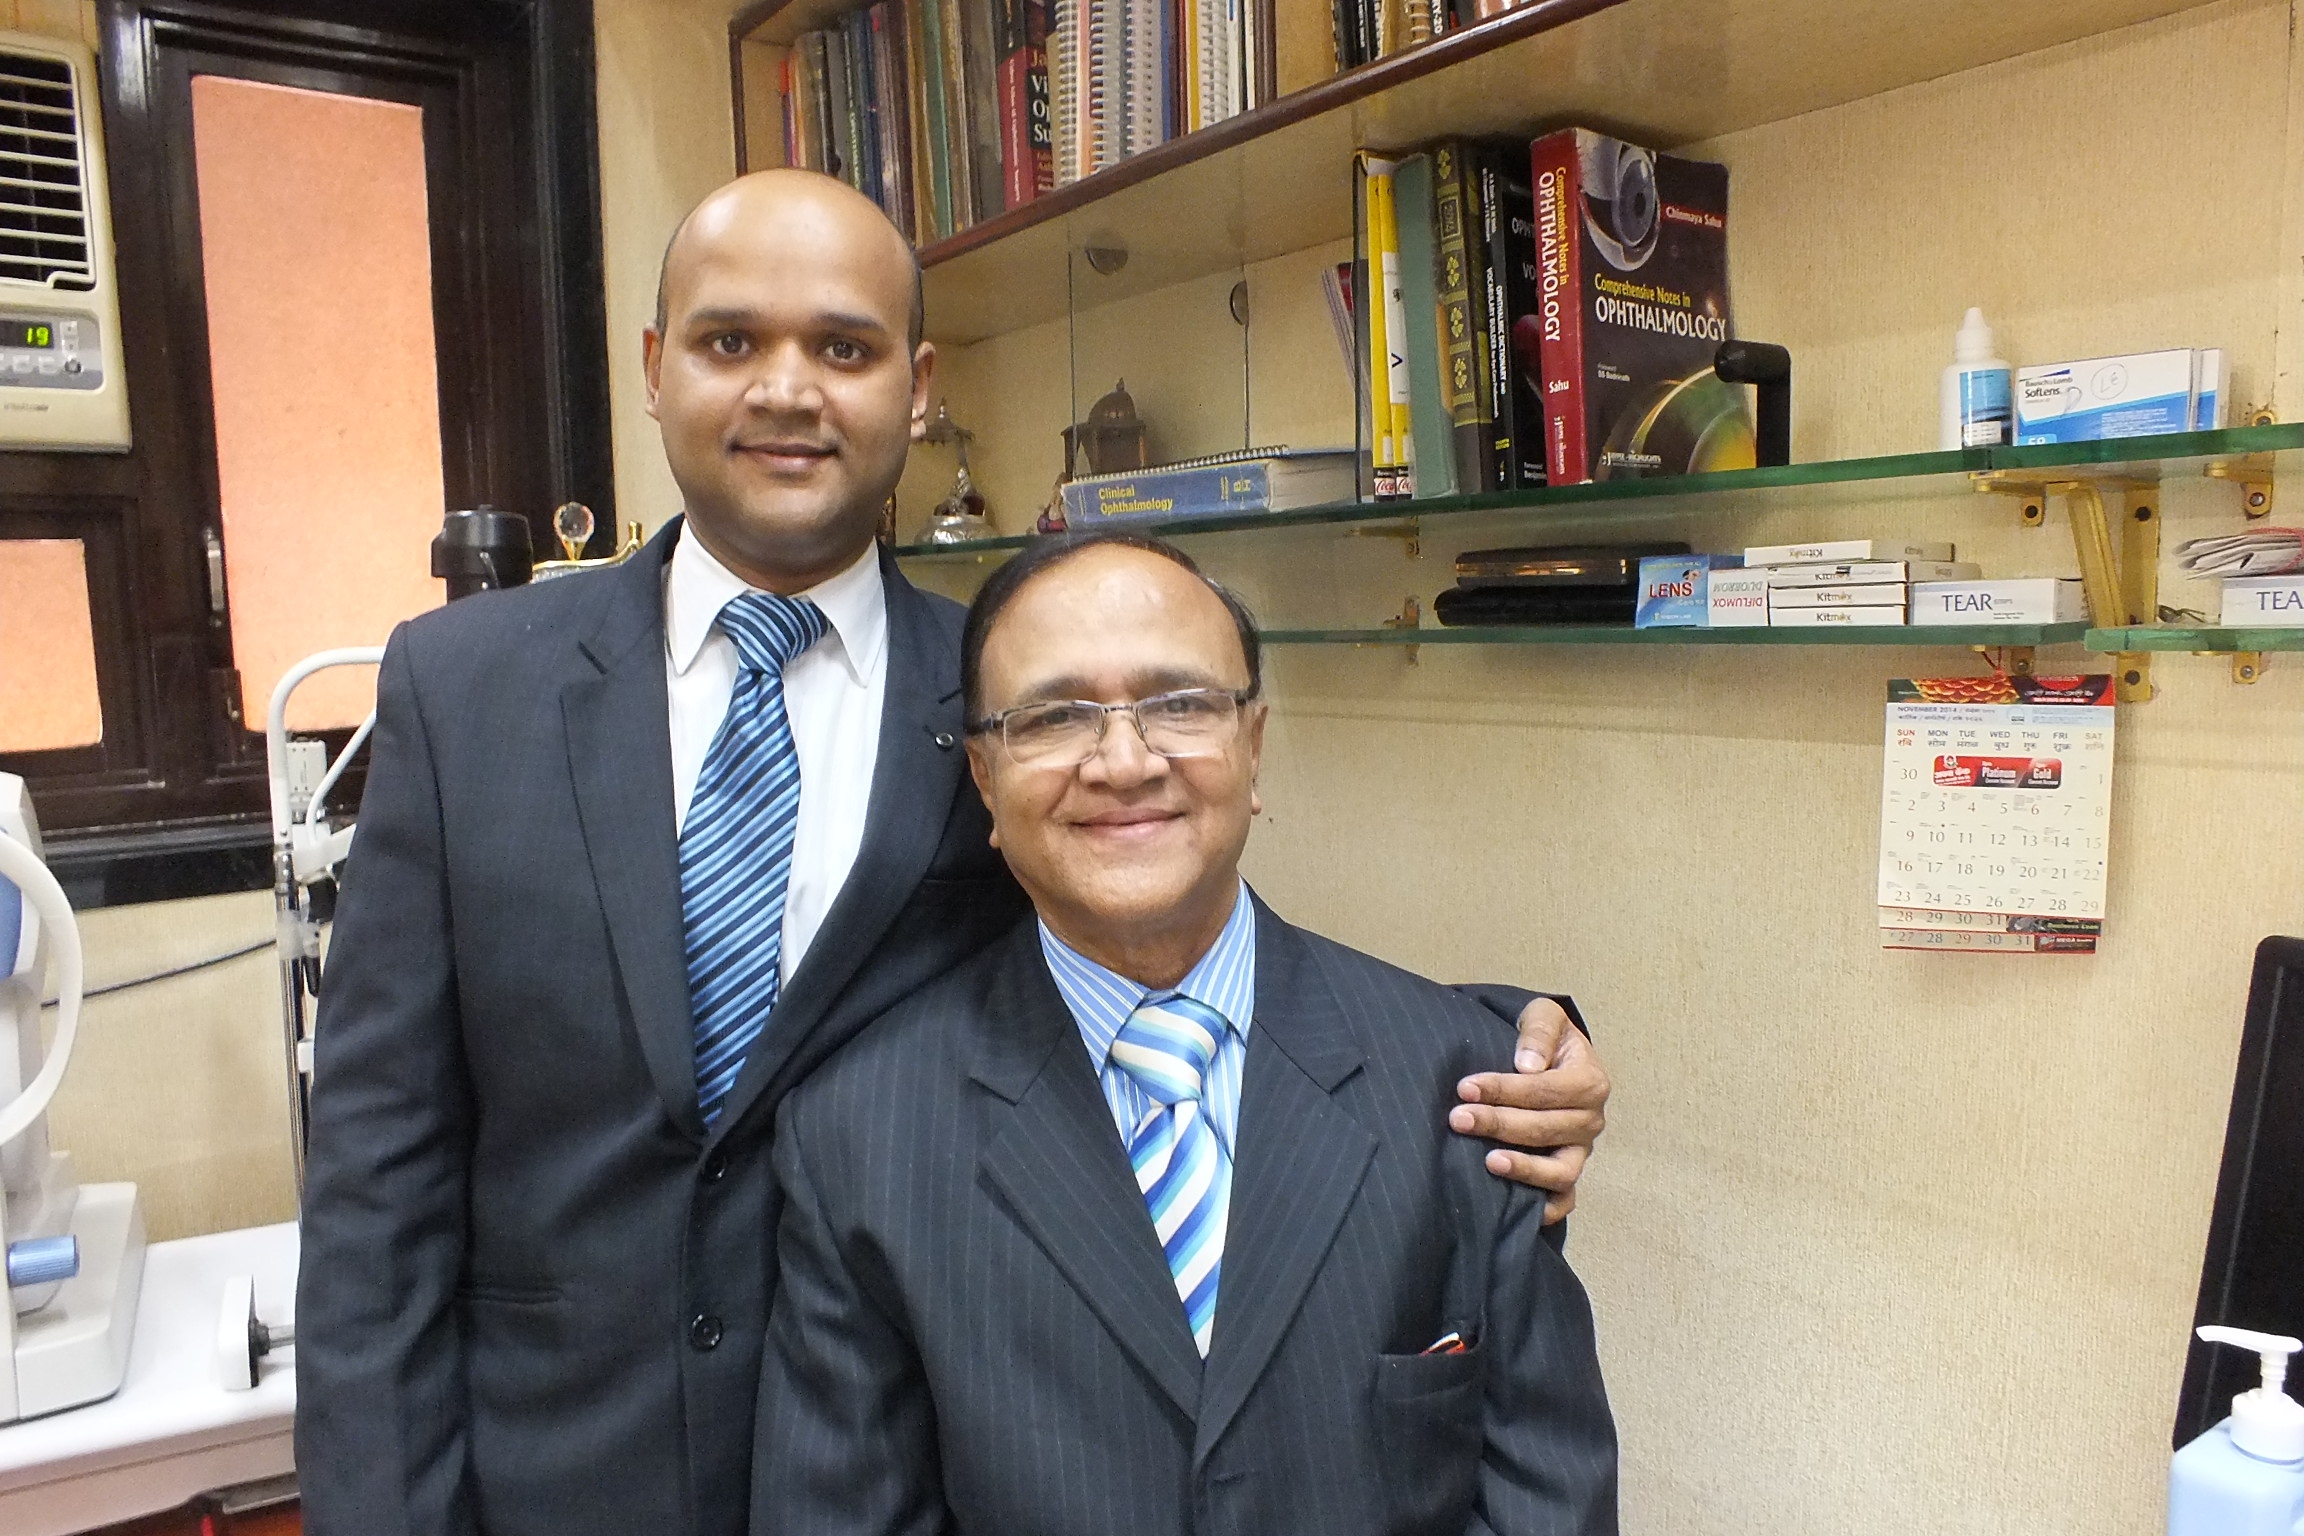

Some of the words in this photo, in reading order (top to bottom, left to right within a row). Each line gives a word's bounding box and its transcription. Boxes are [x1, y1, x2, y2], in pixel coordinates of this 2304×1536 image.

[1556, 167, 1567, 241] Comprehensive
[1705, 214, 1721, 227] Sahu
[1540, 172, 1560, 341] OPHTHALMOLOGY
[1559, 243, 1569, 273] Notes
[1559, 275, 1569, 286] in
[1595, 273, 1654, 301] Comprehensive
[1656, 286, 1680, 306] Notes
[1683, 292, 1691, 307] in
[1595, 296, 1726, 341] OPHTHALMOLOGY
[27, 327, 49, 346] 19
[1549, 380, 1569, 393] Sahu
[2025, 387, 2060, 398] SofLens
[1099, 484, 1135, 499] Clinical
[1101, 497, 1173, 516] Ophthalmology
[1650, 582, 1693, 599] LENS
[1942, 593, 1993, 612] TEAR
[2256, 591, 2304, 610] TEA
[1900, 768, 1917, 780] 30
[1908, 799, 1915, 811] 2
[1938, 800, 1945, 812] 3
[1968, 802, 1975, 812] 4
[2000, 802, 2007, 814] 5
[2031, 804, 2039, 815] 6
[2064, 804, 2072, 815] 7
[2094, 806, 2103, 817] 8
[1906, 830, 1914, 841] 9
[1930, 831, 1945, 843] 10
[1960, 832, 1972, 844] 11
[1992, 833, 2006, 845] 12
[2023, 834, 2037, 846] 13
[2054, 836, 2069, 847] 14
[2086, 837, 2101, 849] 15
[1898, 860, 1912, 872] 16
[1928, 862, 1943, 873] 17
[1958, 863, 1973, 875] 18
[1989, 864, 2005, 876] 19
[2019, 866, 2037, 878] 20
[2051, 867, 2066, 879] 21
[2083, 869, 2099, 880] 22
[1895, 890, 1911, 902] 23
[1924, 892, 1941, 904] 24
[1954, 893, 1971, 906] 25
[1986, 895, 2003, 908] 26
[2017, 897, 2035, 909] 27
[2049, 899, 2067, 911] 28
[2081, 900, 2099, 912] 29
[1896, 911, 1913, 922] 28
[1926, 912, 1943, 923] 29
[1955, 913, 1972, 925] 30
[1986, 913, 2001, 925] 31
[1898, 931, 1914, 942] 27
[1927, 932, 1943, 944] 28
[1955, 933, 1971, 944] 29
[1985, 934, 2002, 945] 30
[2016, 935, 2030, 945] 31
